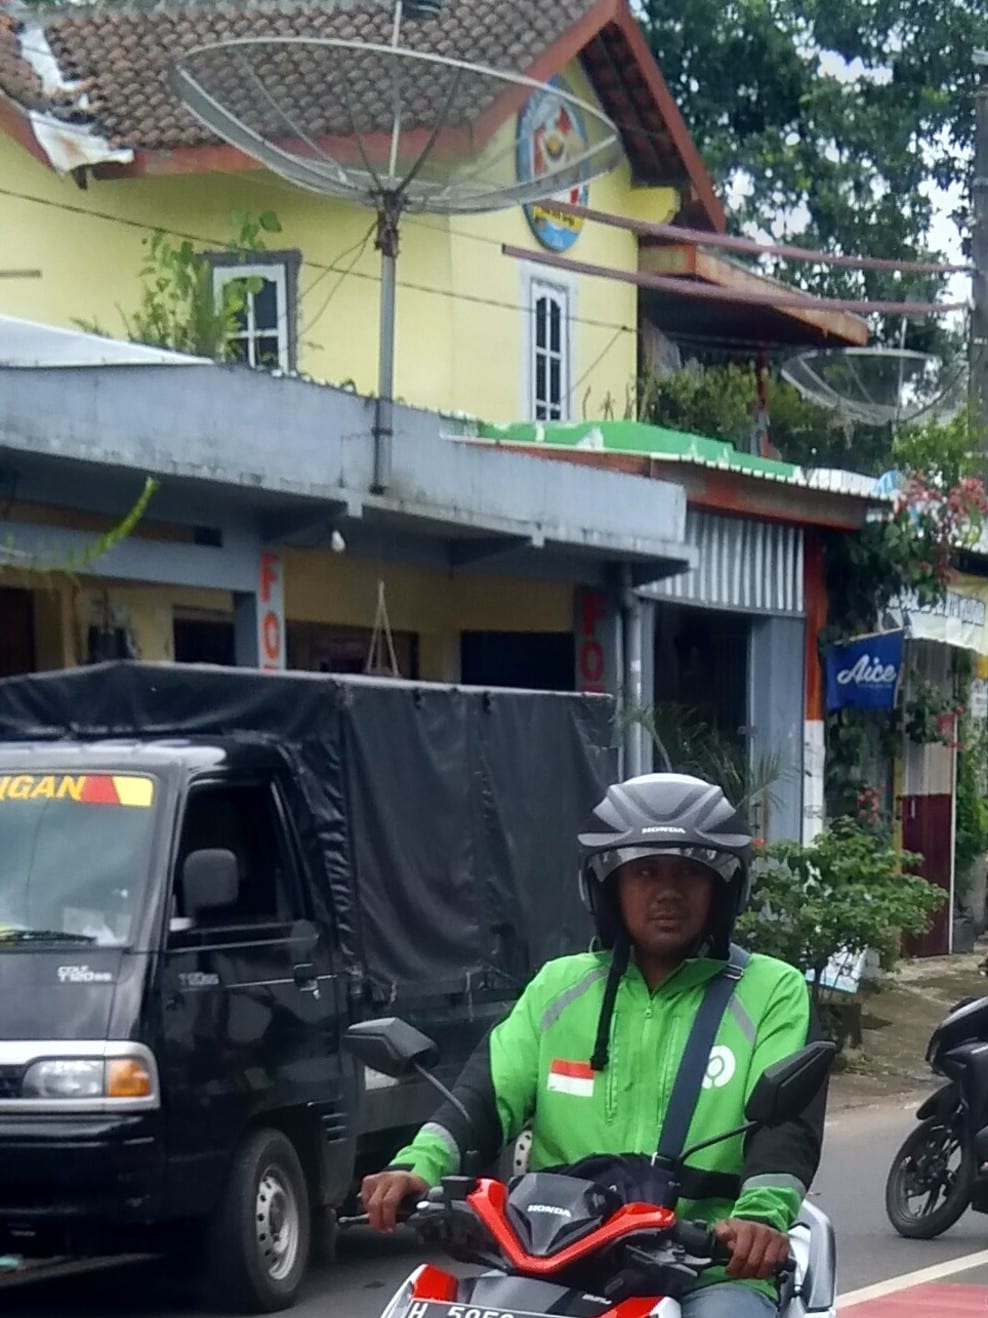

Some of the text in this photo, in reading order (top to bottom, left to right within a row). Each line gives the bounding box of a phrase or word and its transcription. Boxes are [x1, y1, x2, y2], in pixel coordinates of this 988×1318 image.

[837, 653, 897, 685] Aice
[641, 826, 687, 835] HONDA
[527, 1204, 571, 1218] HONDA
